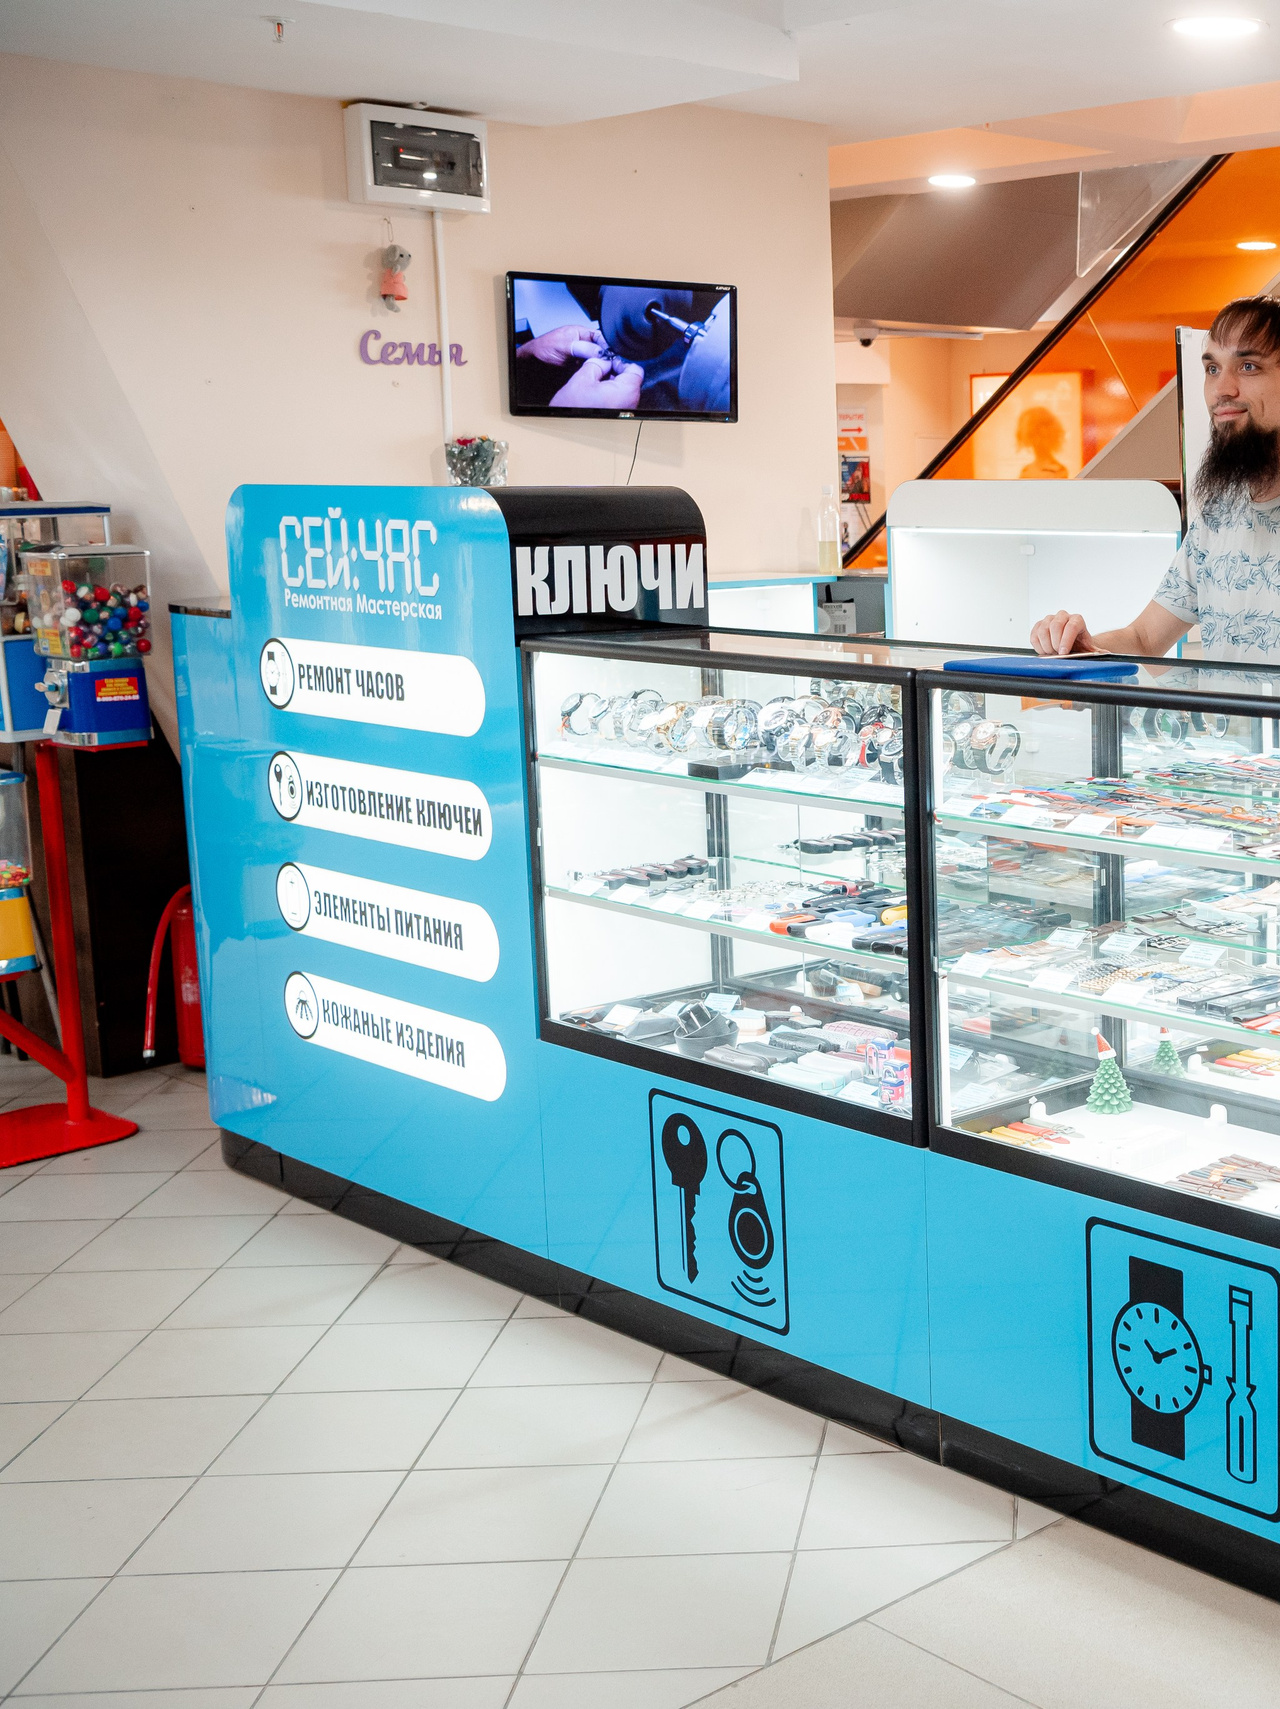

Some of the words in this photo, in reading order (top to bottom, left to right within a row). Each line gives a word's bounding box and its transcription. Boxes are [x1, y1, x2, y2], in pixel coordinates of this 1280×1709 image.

[359, 329, 469, 367] Семья
[515, 543, 705, 617] КЛЮЧИ
[284, 588, 354, 613] Ремонтная
[355, 594, 444, 621] Мастерская
[298, 663, 351, 695] РЕМОНТ
[354, 669, 405, 702] ЧАСОВ
[306, 779, 412, 822] ИЗГОТОВЛЕНИЕ
[314, 889, 392, 934] ЭЛЕМЕНТЫ
[395, 909, 463, 951] ПИТАНИЯ
[322, 998, 393, 1045] КОЖАНЫЕ
[395, 1020, 466, 1068] ИЗДЕЛИЯ
